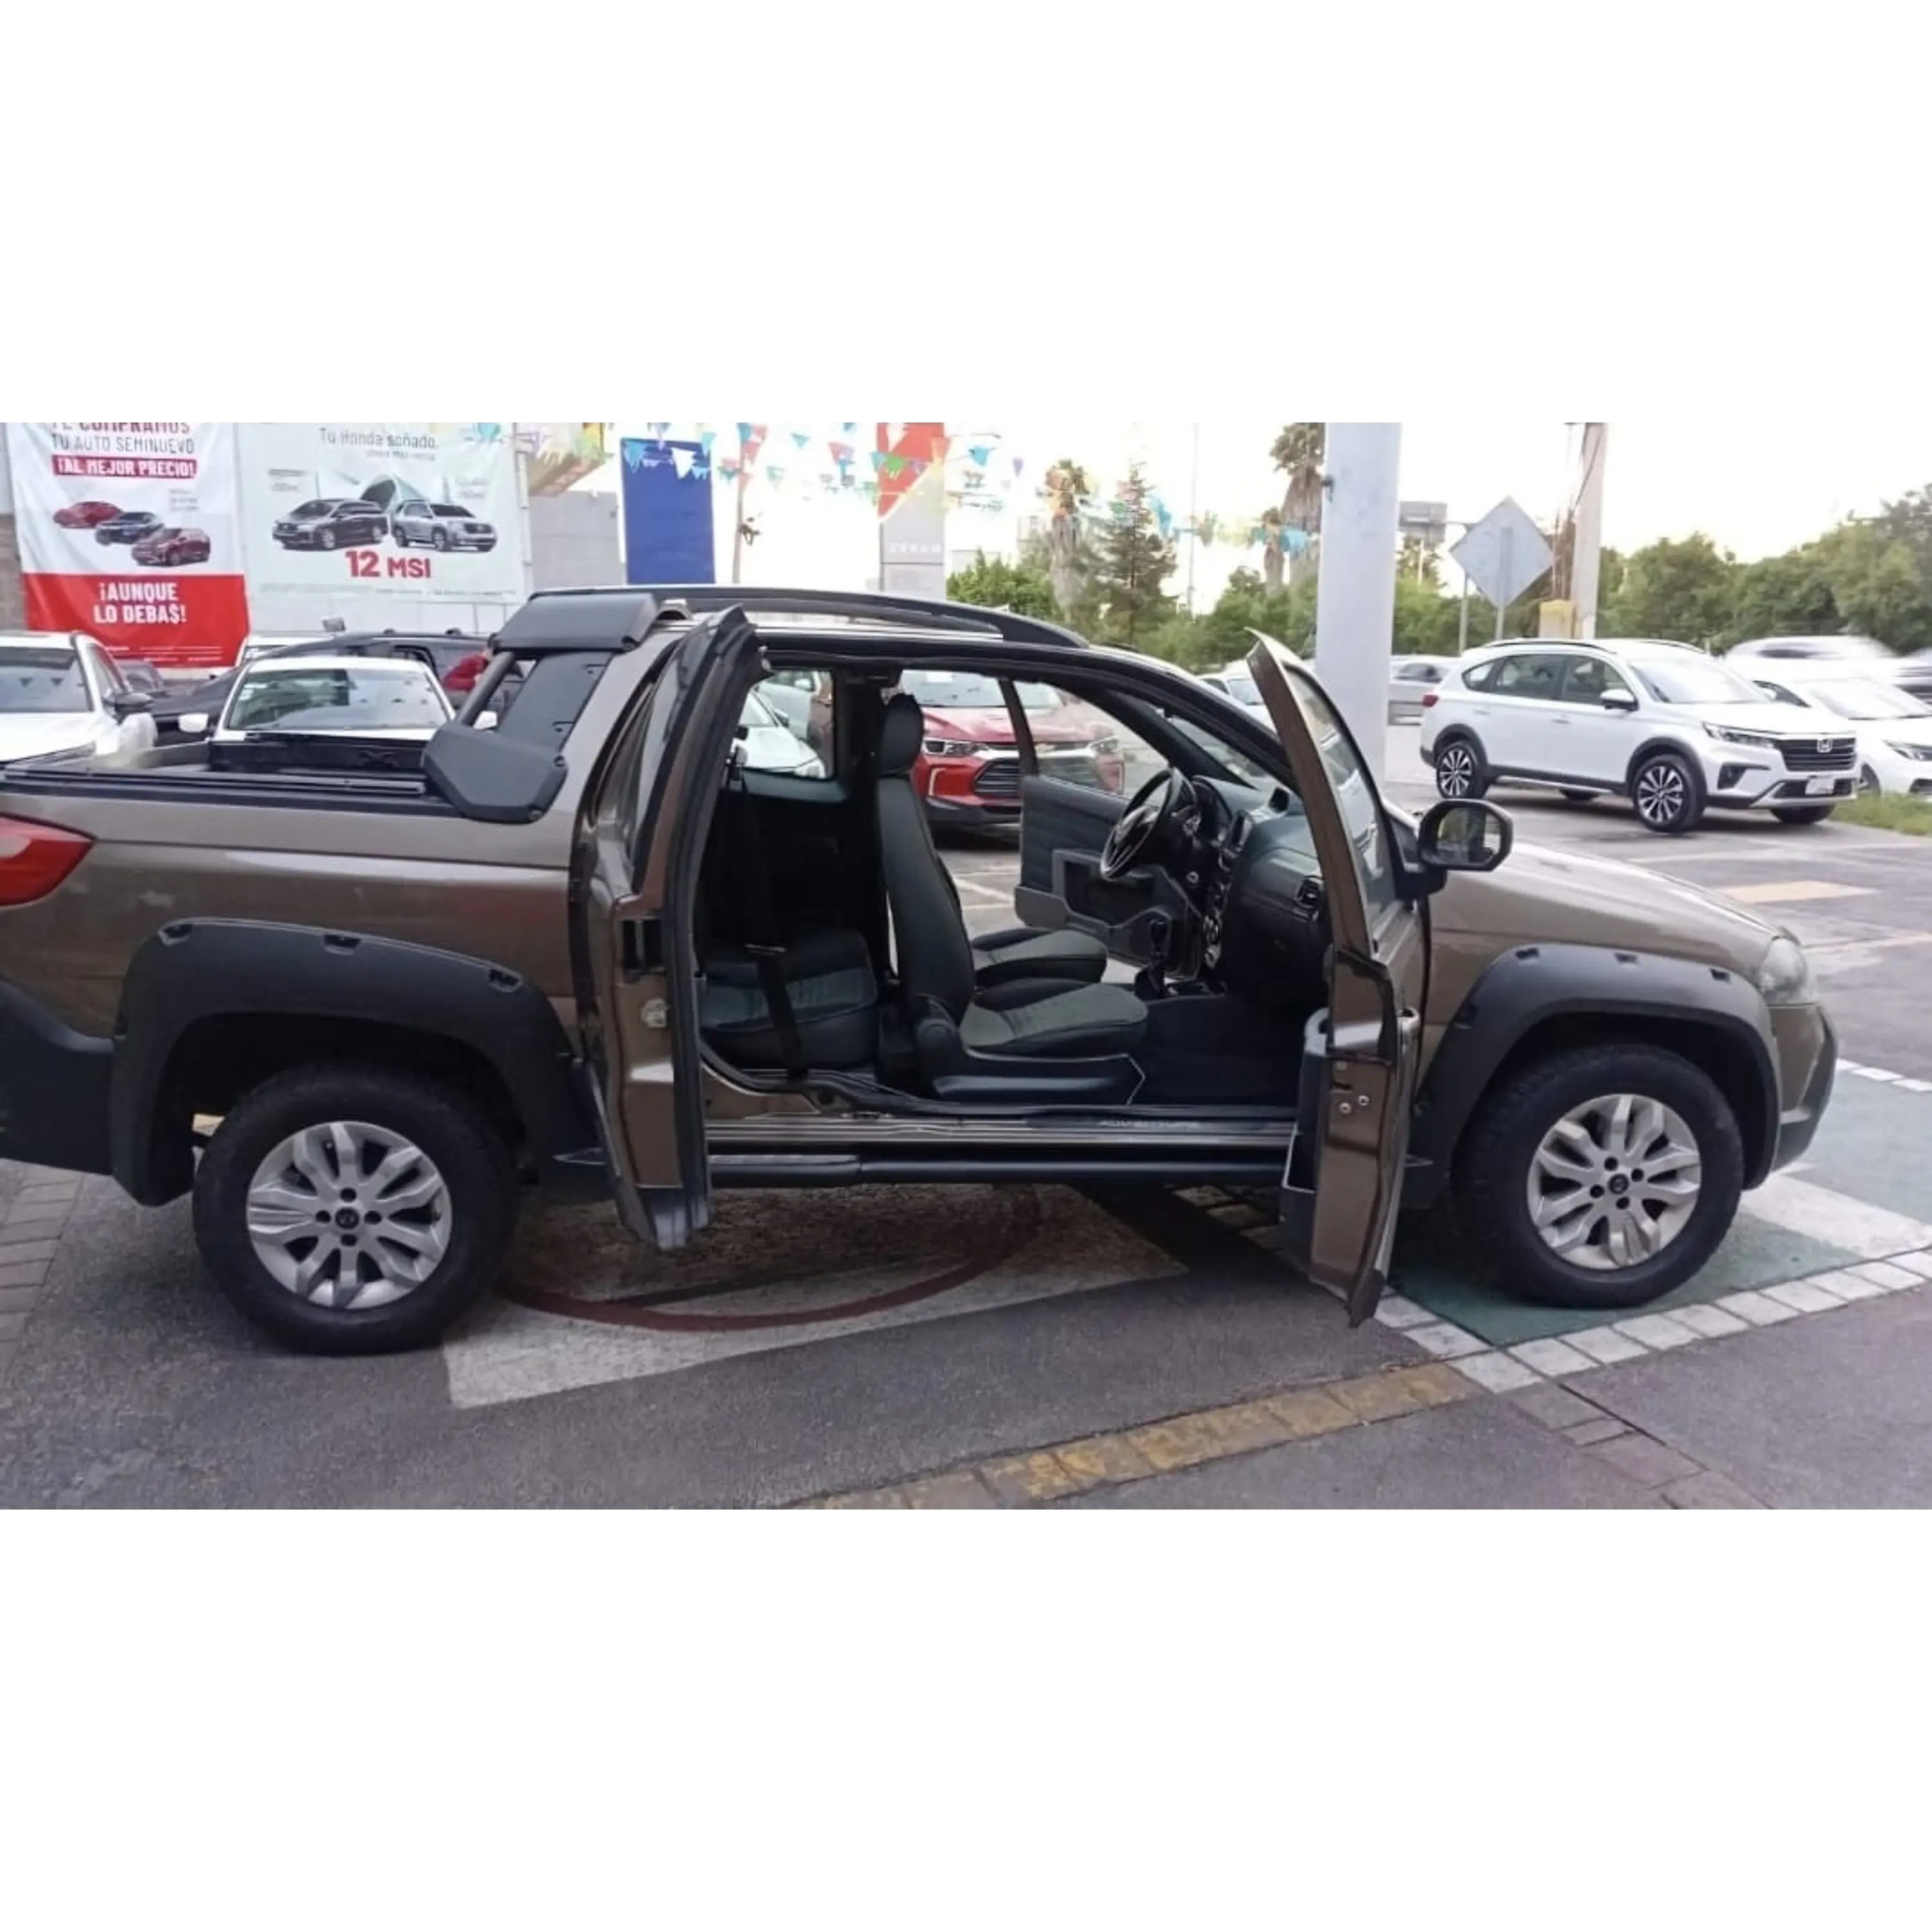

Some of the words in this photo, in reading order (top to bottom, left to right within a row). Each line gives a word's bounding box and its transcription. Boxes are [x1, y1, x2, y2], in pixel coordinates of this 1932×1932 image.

[52, 433, 69, 450] TU
[74, 435, 110, 451] AUTO
[117, 437, 194, 454] SEMINUEVO
[317, 428, 336, 444] Tu
[86, 460, 135, 477] MEJOR
[138, 462, 194, 477] PRECIO!
[345, 551, 380, 578] 12
[387, 558, 431, 579] MSI
[99, 582, 179, 603] ¡AUNQUE
[93, 605, 118, 624] LO
